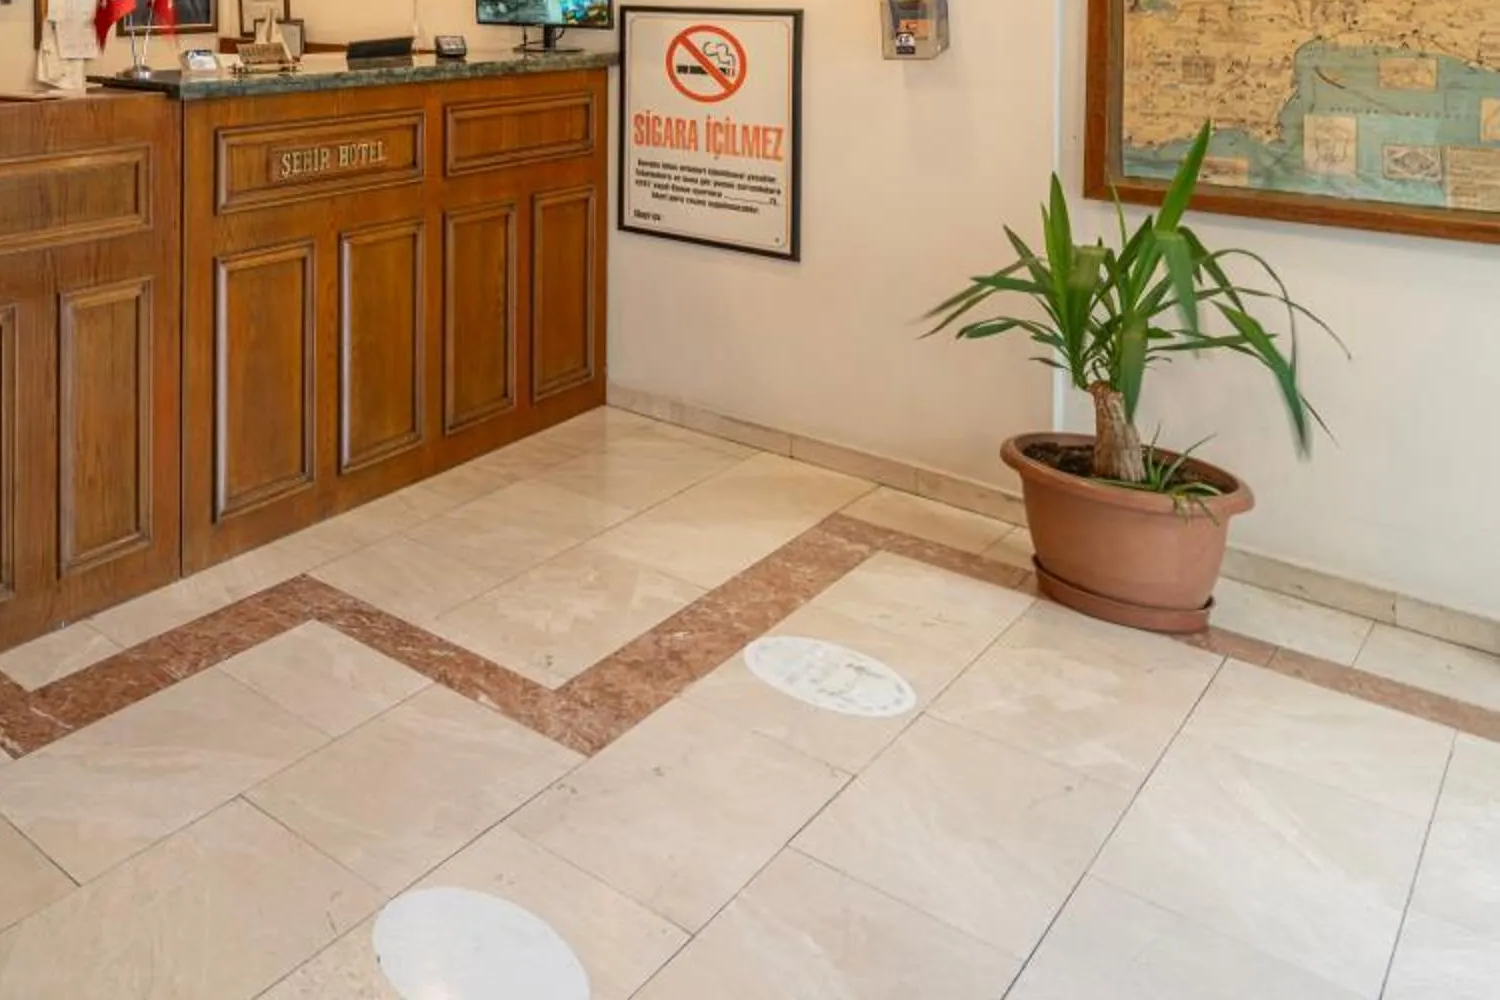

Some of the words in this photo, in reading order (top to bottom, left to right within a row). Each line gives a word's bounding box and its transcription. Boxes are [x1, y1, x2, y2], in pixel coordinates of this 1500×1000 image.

[339, 140, 387, 168] HOTEL
[634, 109, 699, 152] SİGARA
[705, 113, 785, 162] İÇİLMEZ
